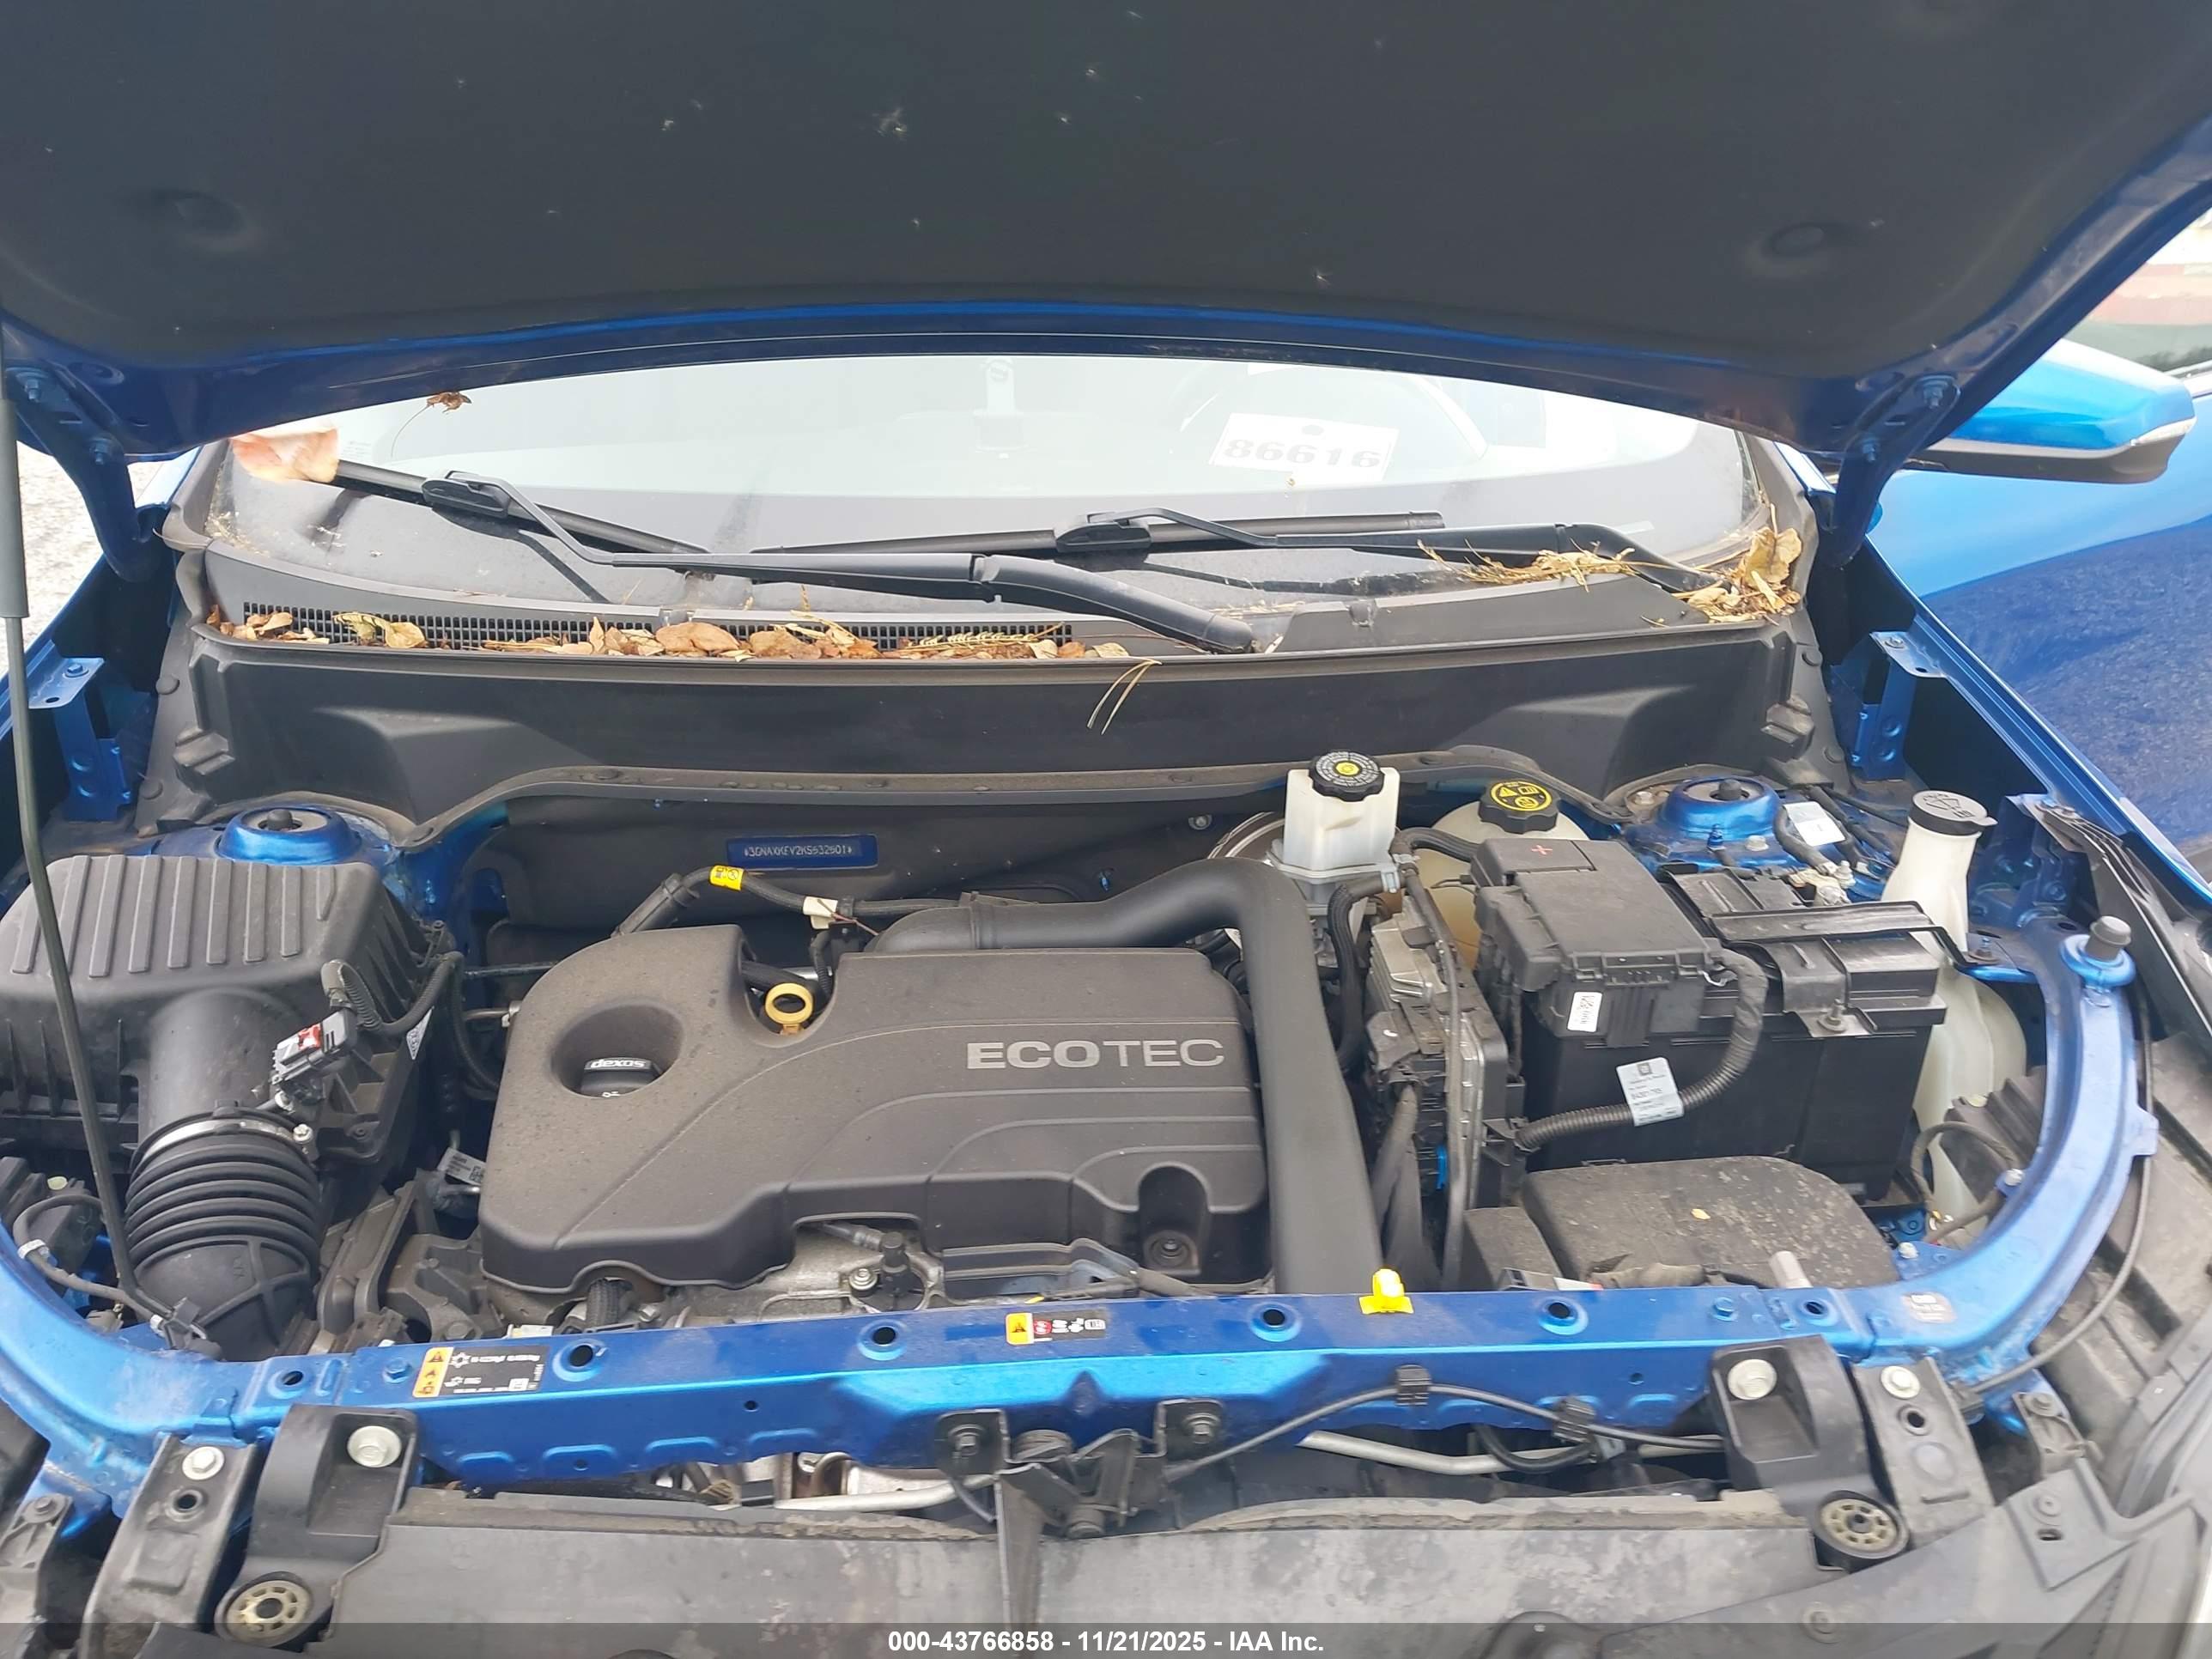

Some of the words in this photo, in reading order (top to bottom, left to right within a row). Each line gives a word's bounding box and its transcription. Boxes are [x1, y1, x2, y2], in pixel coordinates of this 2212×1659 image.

[1223, 439, 1382, 468] 86616
[590, 1059, 647, 1068] dexos
[967, 1038, 1224, 1069] ECOTEC
